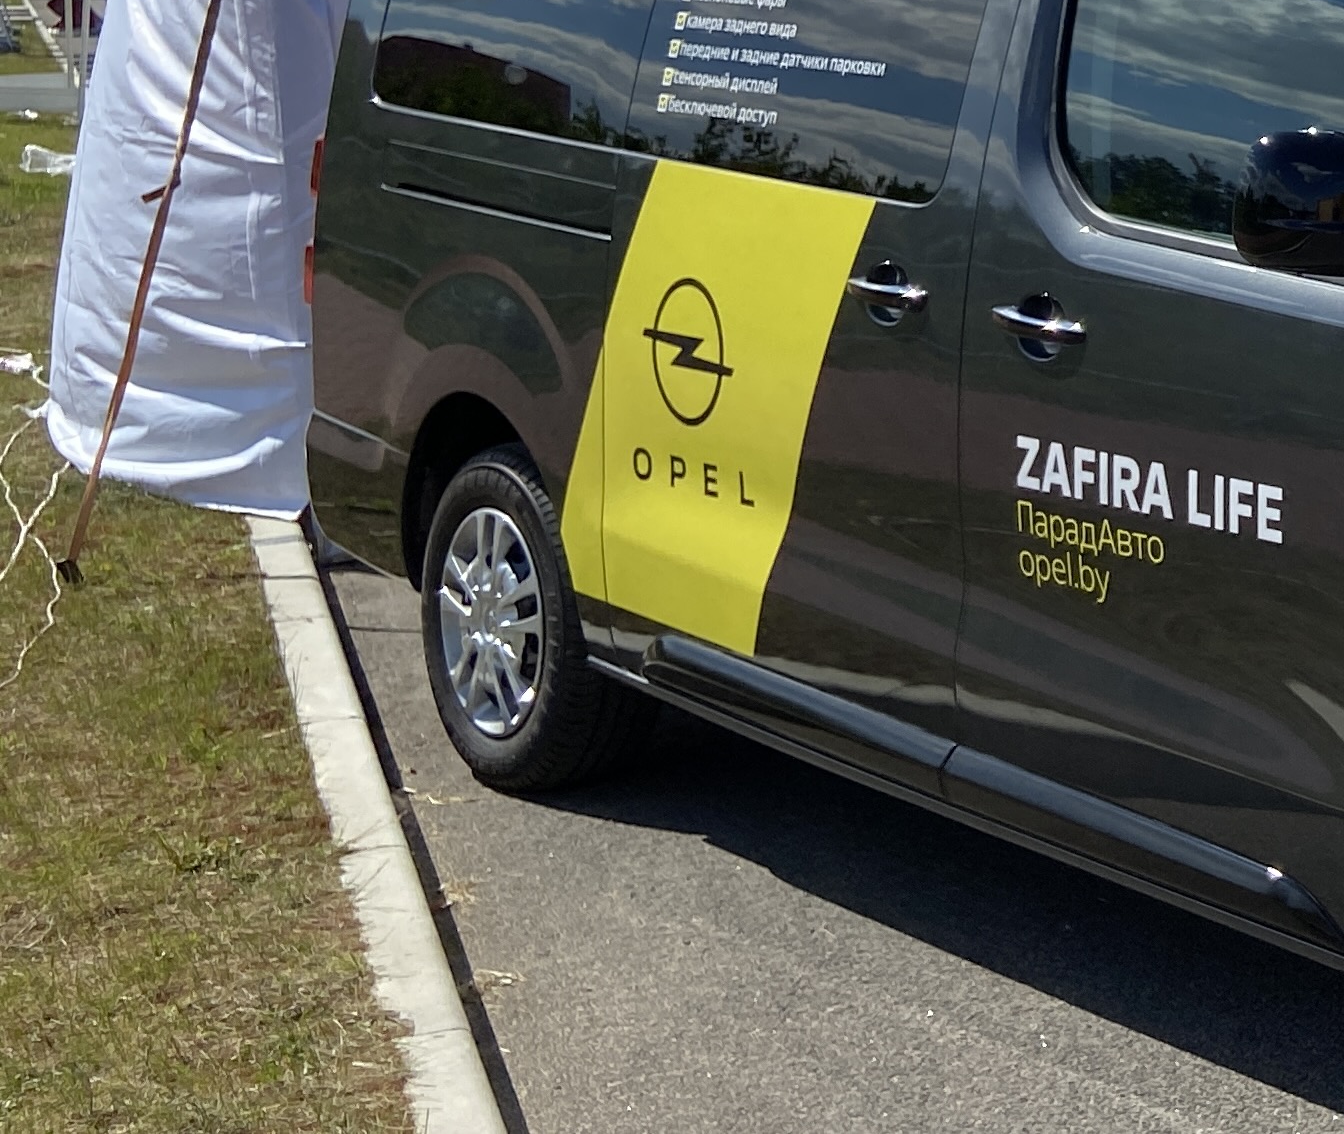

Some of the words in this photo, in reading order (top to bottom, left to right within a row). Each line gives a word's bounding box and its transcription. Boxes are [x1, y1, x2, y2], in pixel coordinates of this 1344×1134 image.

[686, 17, 723, 35] камера
[724, 20, 768, 37] заднего
[769, 23, 798, 39] вида
[673, 70, 731, 90] сенсорный
[730, 77, 779, 95] дисплей
[680, 43, 730, 60] передние
[730, 48, 740, 60] и
[740, 48, 780, 66] задние
[780, 52, 828, 71] датчики
[829, 56, 887, 78] парковки
[667, 96, 737, 118] бесключевой
[737, 108, 778, 128] доступ
[632, 446, 757, 509] OPEL
[1016, 434, 1174, 520] ZAFIRA
[1186, 468, 1284, 545] LIFE
[1016, 499, 1165, 565] ПарадАвто
[1018, 549, 1112, 604] opel.by
